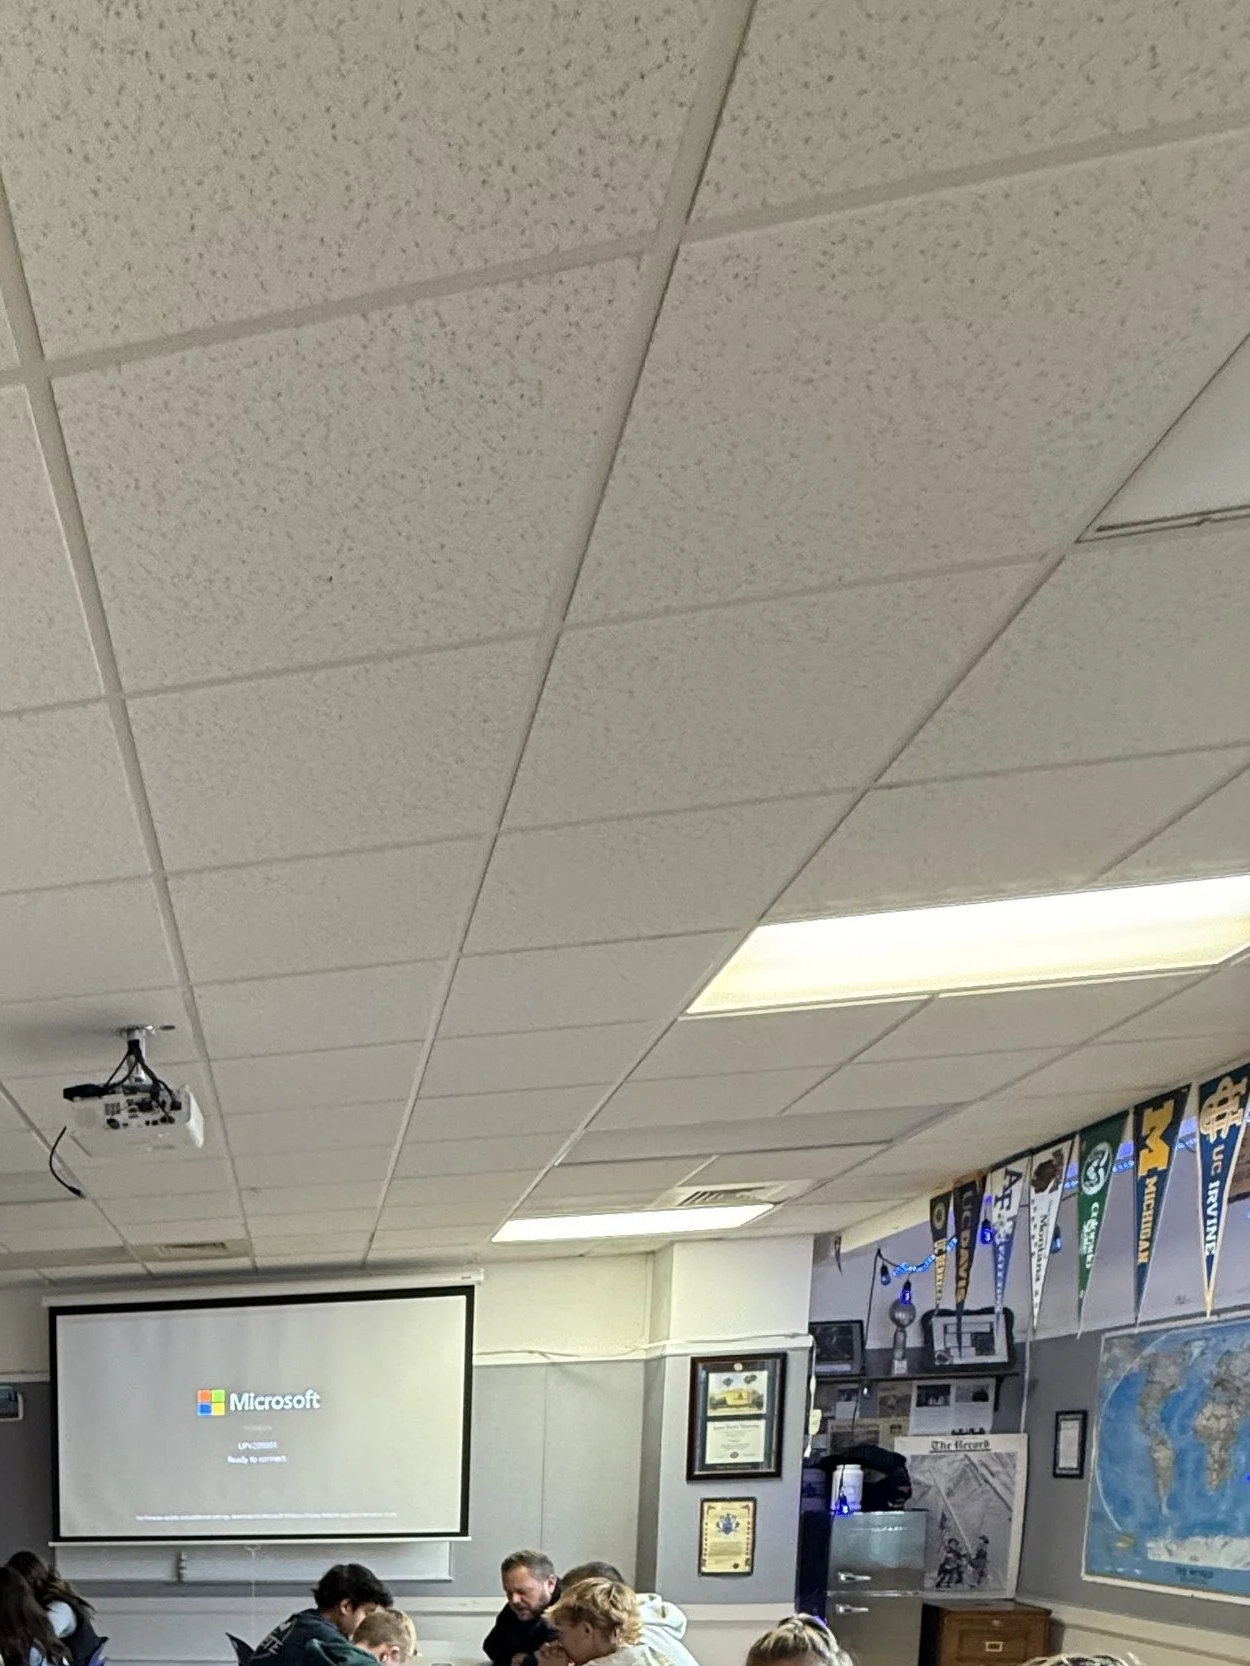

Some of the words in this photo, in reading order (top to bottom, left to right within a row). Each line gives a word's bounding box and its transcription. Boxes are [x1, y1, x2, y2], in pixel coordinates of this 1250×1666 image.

[1137, 1099, 1174, 1177] M
[1212, 1144, 1225, 1176] UC
[962, 1190, 973, 1226] UC
[1138, 1175, 1157, 1264] MICHIGAN
[1205, 1180, 1221, 1256] IRVINE
[956, 1229, 971, 1303] DAVIS
[1034, 1214, 1049, 1282] Montana
[230, 1389, 321, 1411] Microsoft
[930, 1440, 951, 1449] The
[954, 1439, 990, 1449] Record
